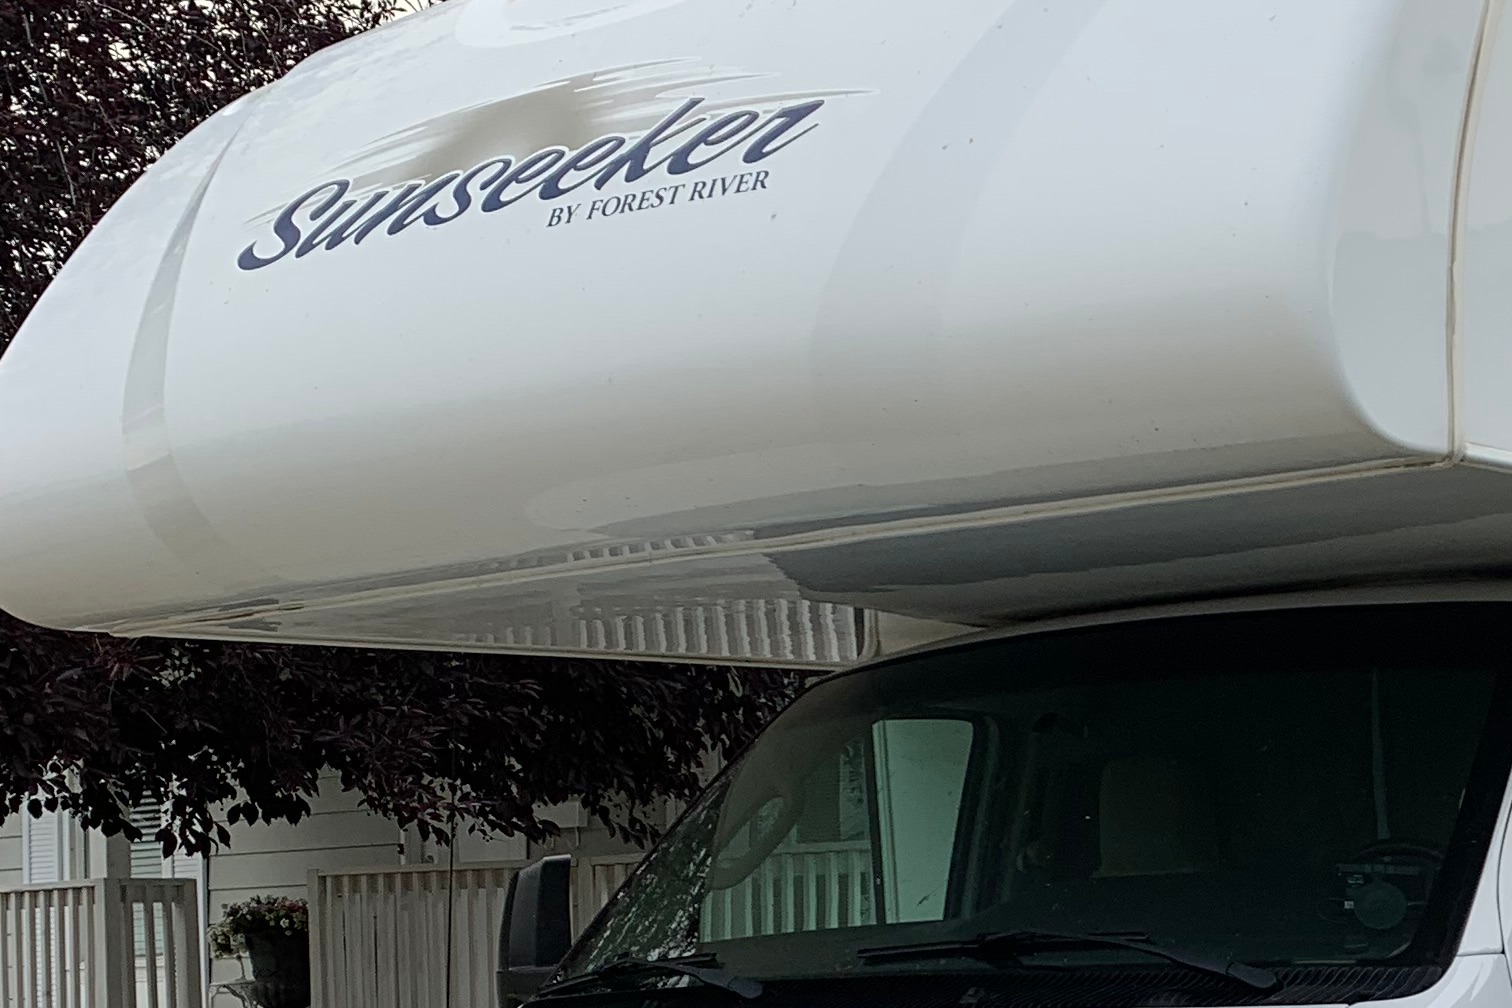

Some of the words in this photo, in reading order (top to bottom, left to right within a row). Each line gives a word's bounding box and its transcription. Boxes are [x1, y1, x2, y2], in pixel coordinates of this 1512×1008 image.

[237, 97, 825, 270] Sunseeker
[547, 203, 580, 228] BY
[587, 184, 686, 220] FOREST
[688, 170, 770, 203] RIVER
